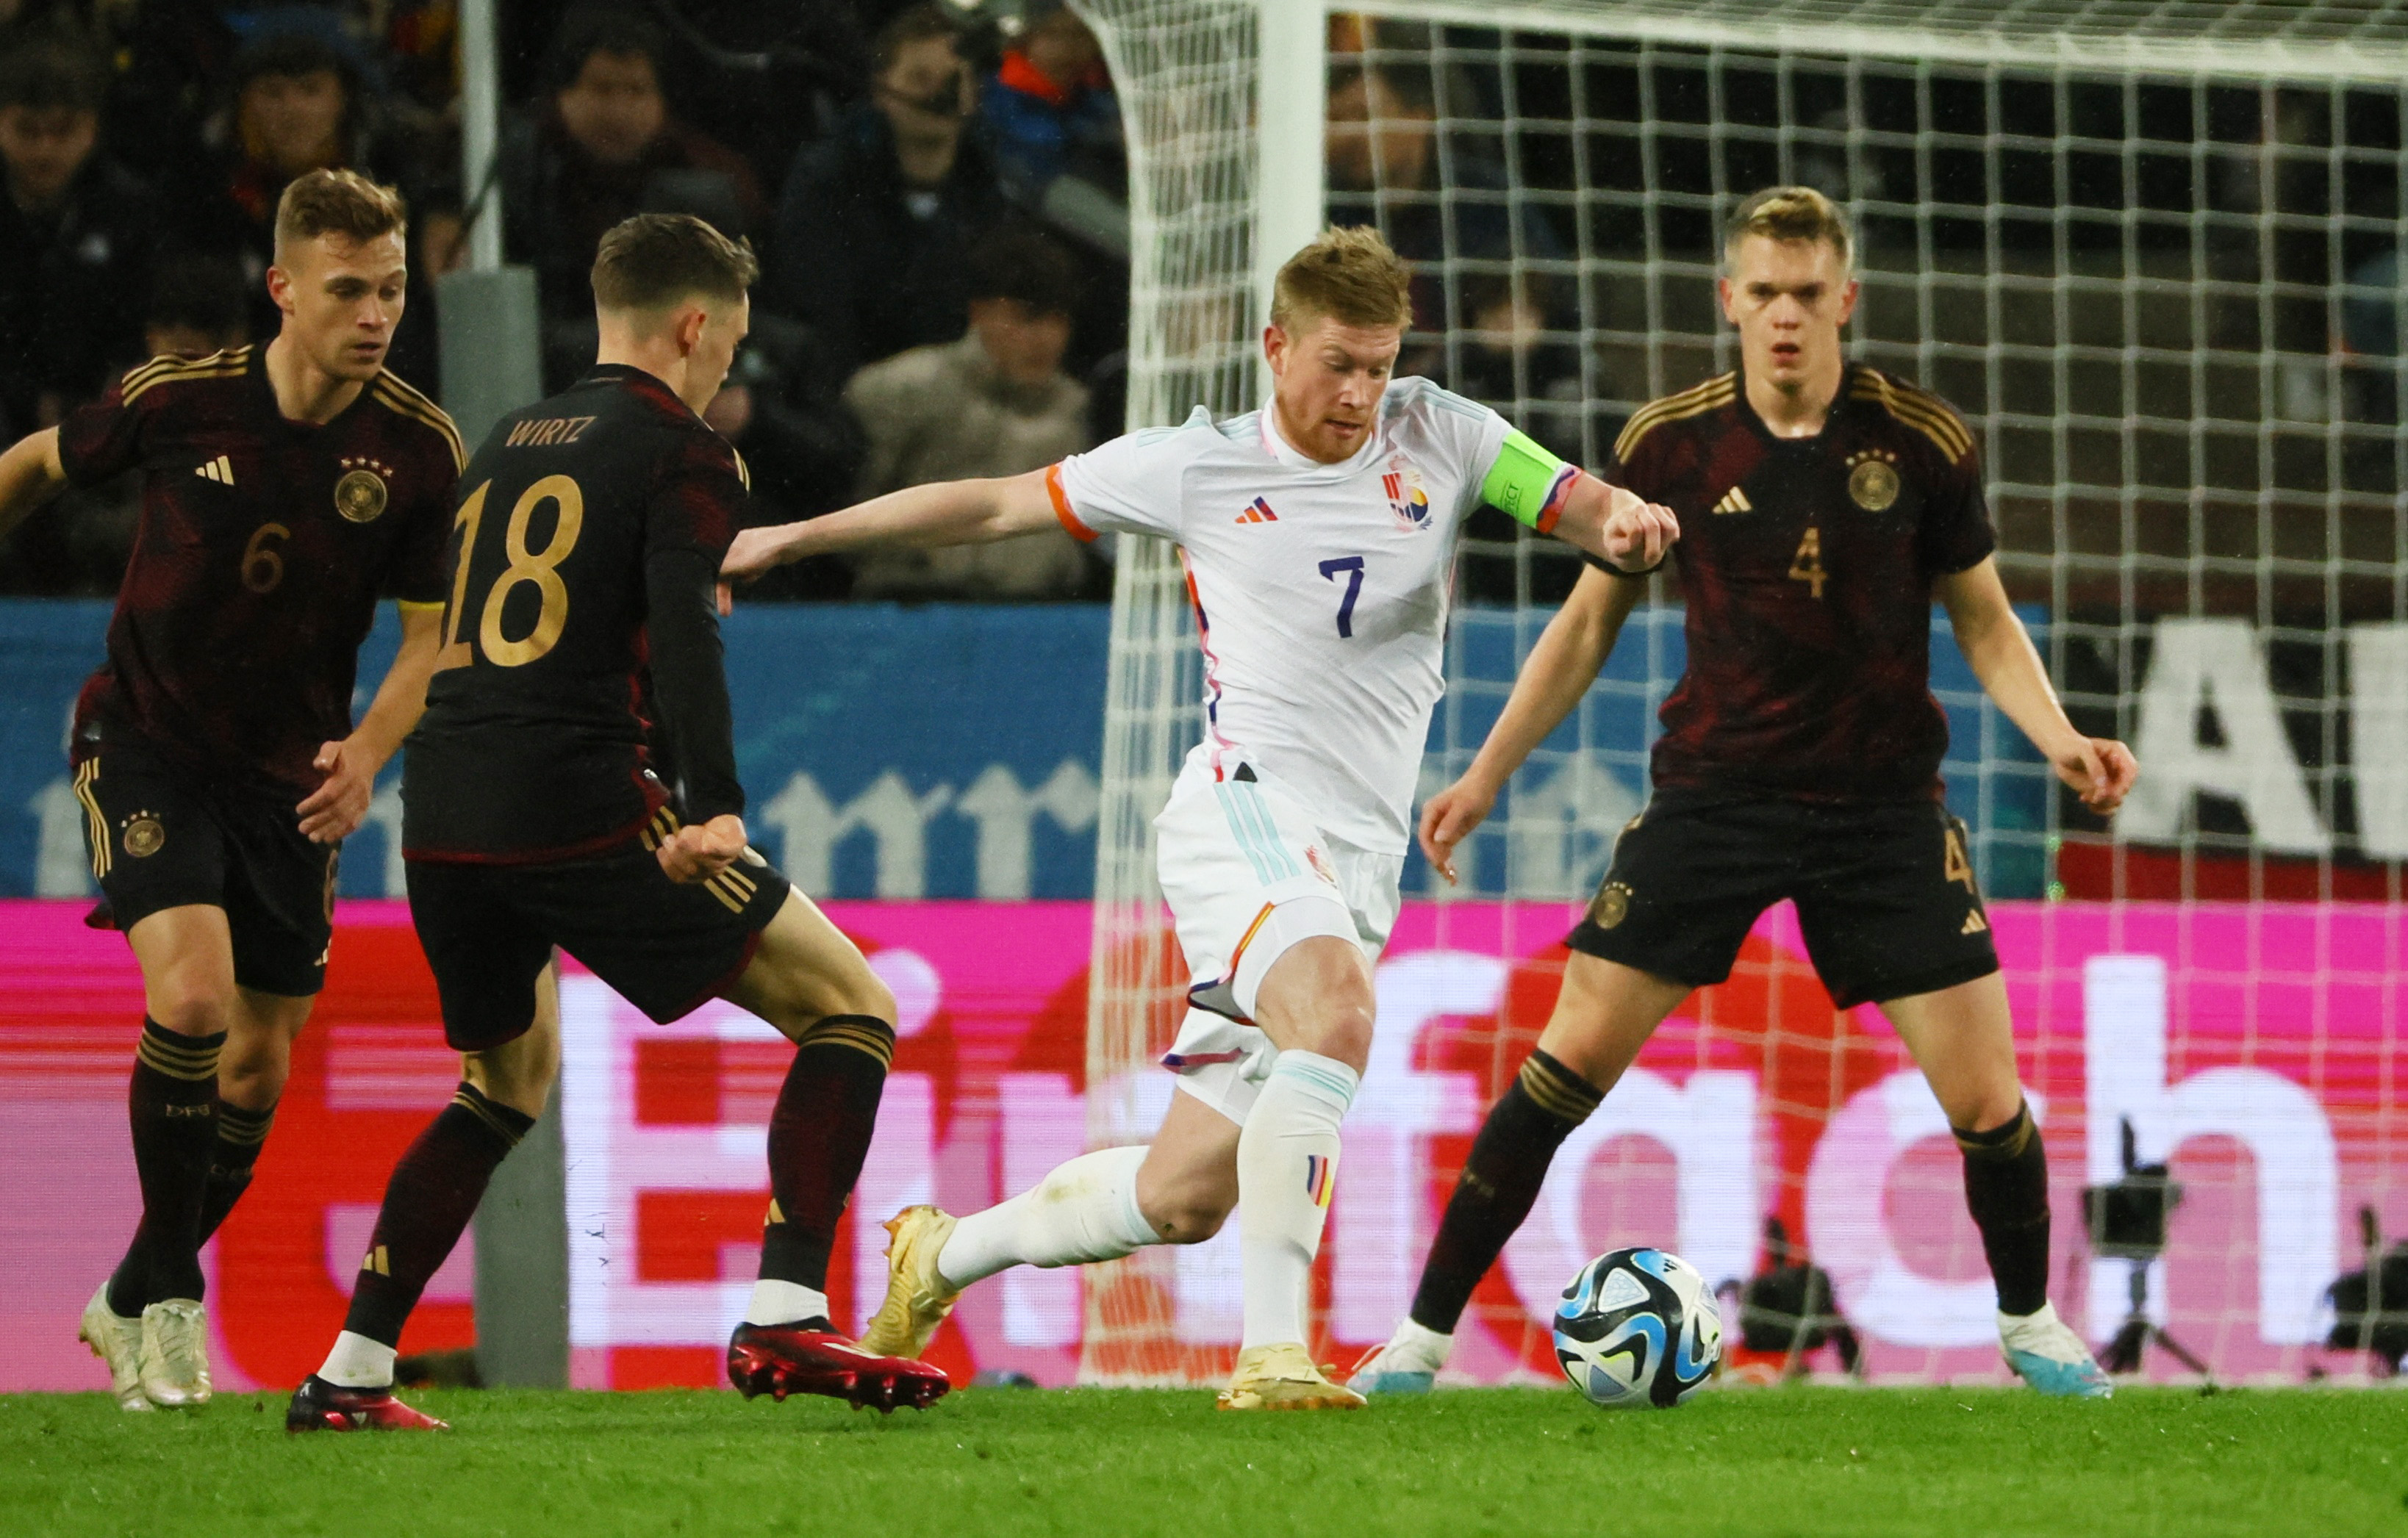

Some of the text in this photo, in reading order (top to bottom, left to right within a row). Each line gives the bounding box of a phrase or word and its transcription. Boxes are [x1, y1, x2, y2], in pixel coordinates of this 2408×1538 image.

[505, 416, 598, 447] WIRTZ
[241, 522, 290, 592] 6
[434, 474, 584, 670] 18
[1788, 527, 1827, 597] 4
[1318, 556, 1364, 639] 7
[1945, 830, 1973, 894] 4
